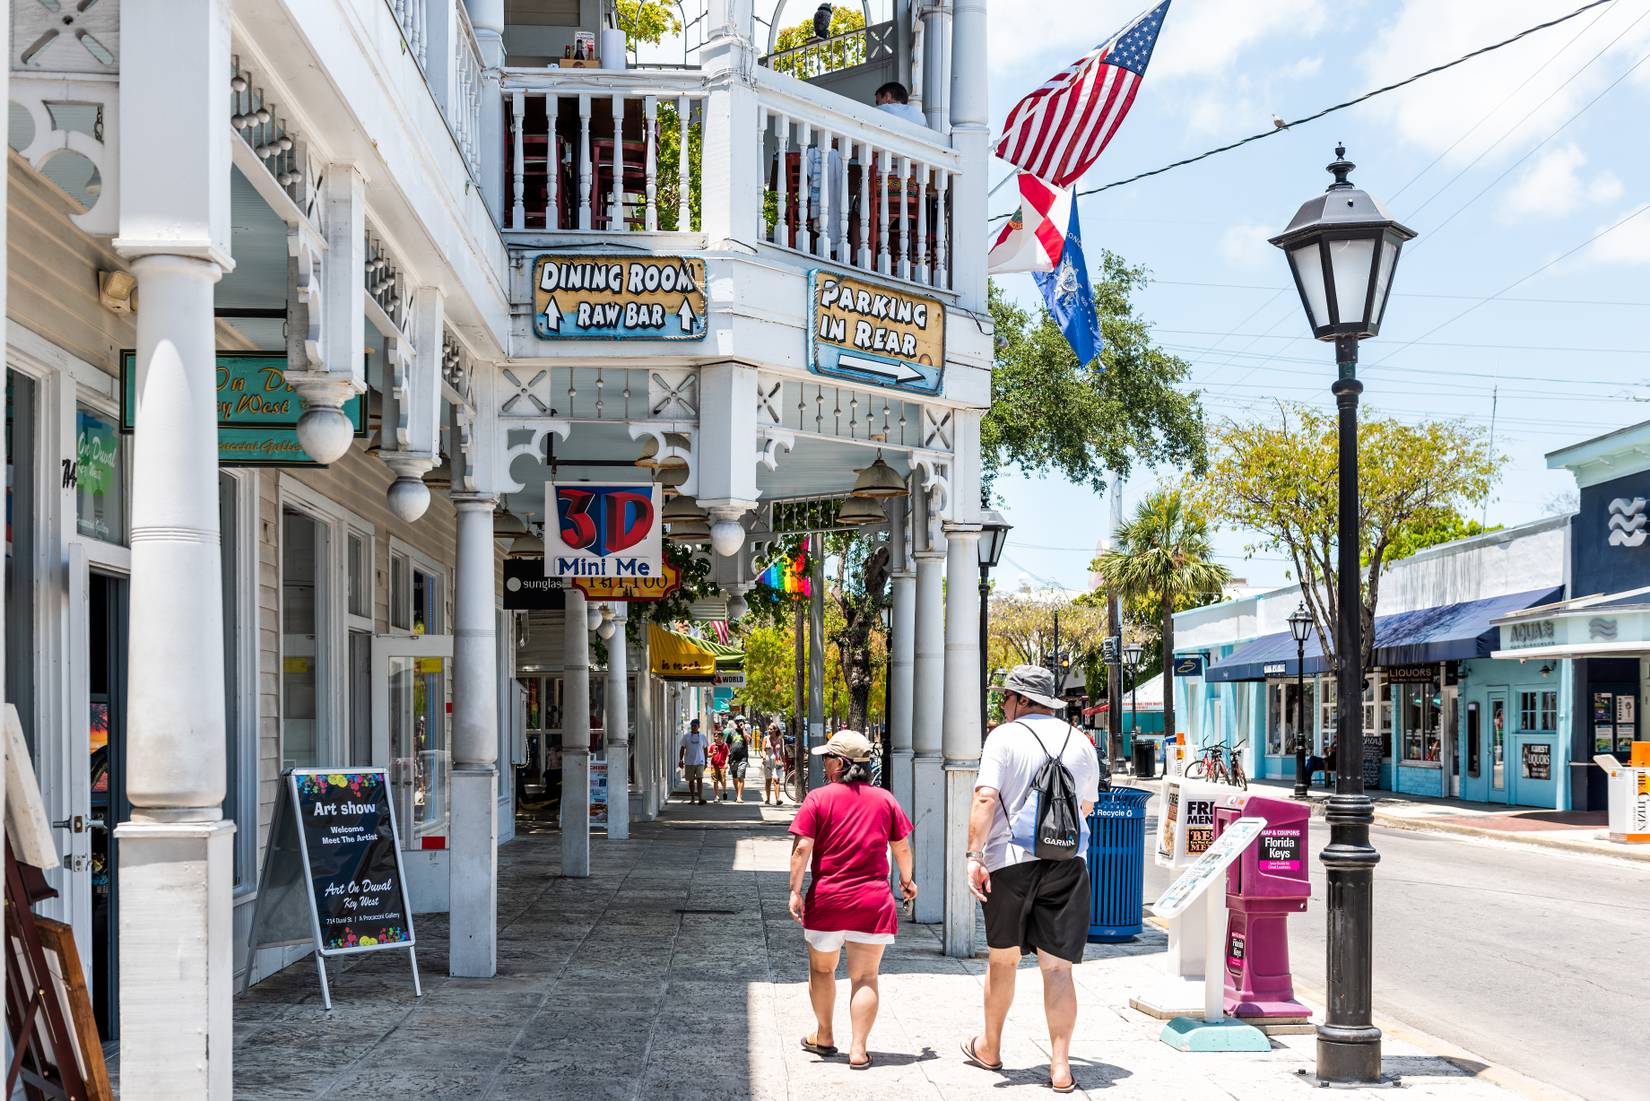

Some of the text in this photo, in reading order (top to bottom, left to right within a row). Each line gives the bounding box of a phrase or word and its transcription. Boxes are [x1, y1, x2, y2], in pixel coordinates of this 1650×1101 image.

[540, 261, 697, 294] DINING ROOM
[821, 280, 928, 330] PARKING
[577, 301, 665, 329] RAW BAR
[820, 314, 918, 358] IN REAR
[236, 394, 289, 414] West
[559, 489, 654, 553] 3D
[558, 558, 650, 576] Mini Me
[523, 578, 562, 591] sunglas
[1389, 668, 1432, 677] LIQUORS
[314, 801, 376, 816] Art show
[1097, 809, 1125, 819] Recycle
[330, 826, 364, 834] Welcome
[322, 837, 340, 845] Meet
[357, 833, 379, 842] Artist
[1044, 837, 1075, 847] GARMIN
[1265, 837, 1295, 848] Florida
[1269, 847, 1291, 861] Keys
[324, 878, 392, 896] Art On Duval
[343, 896, 379, 911] Key West
